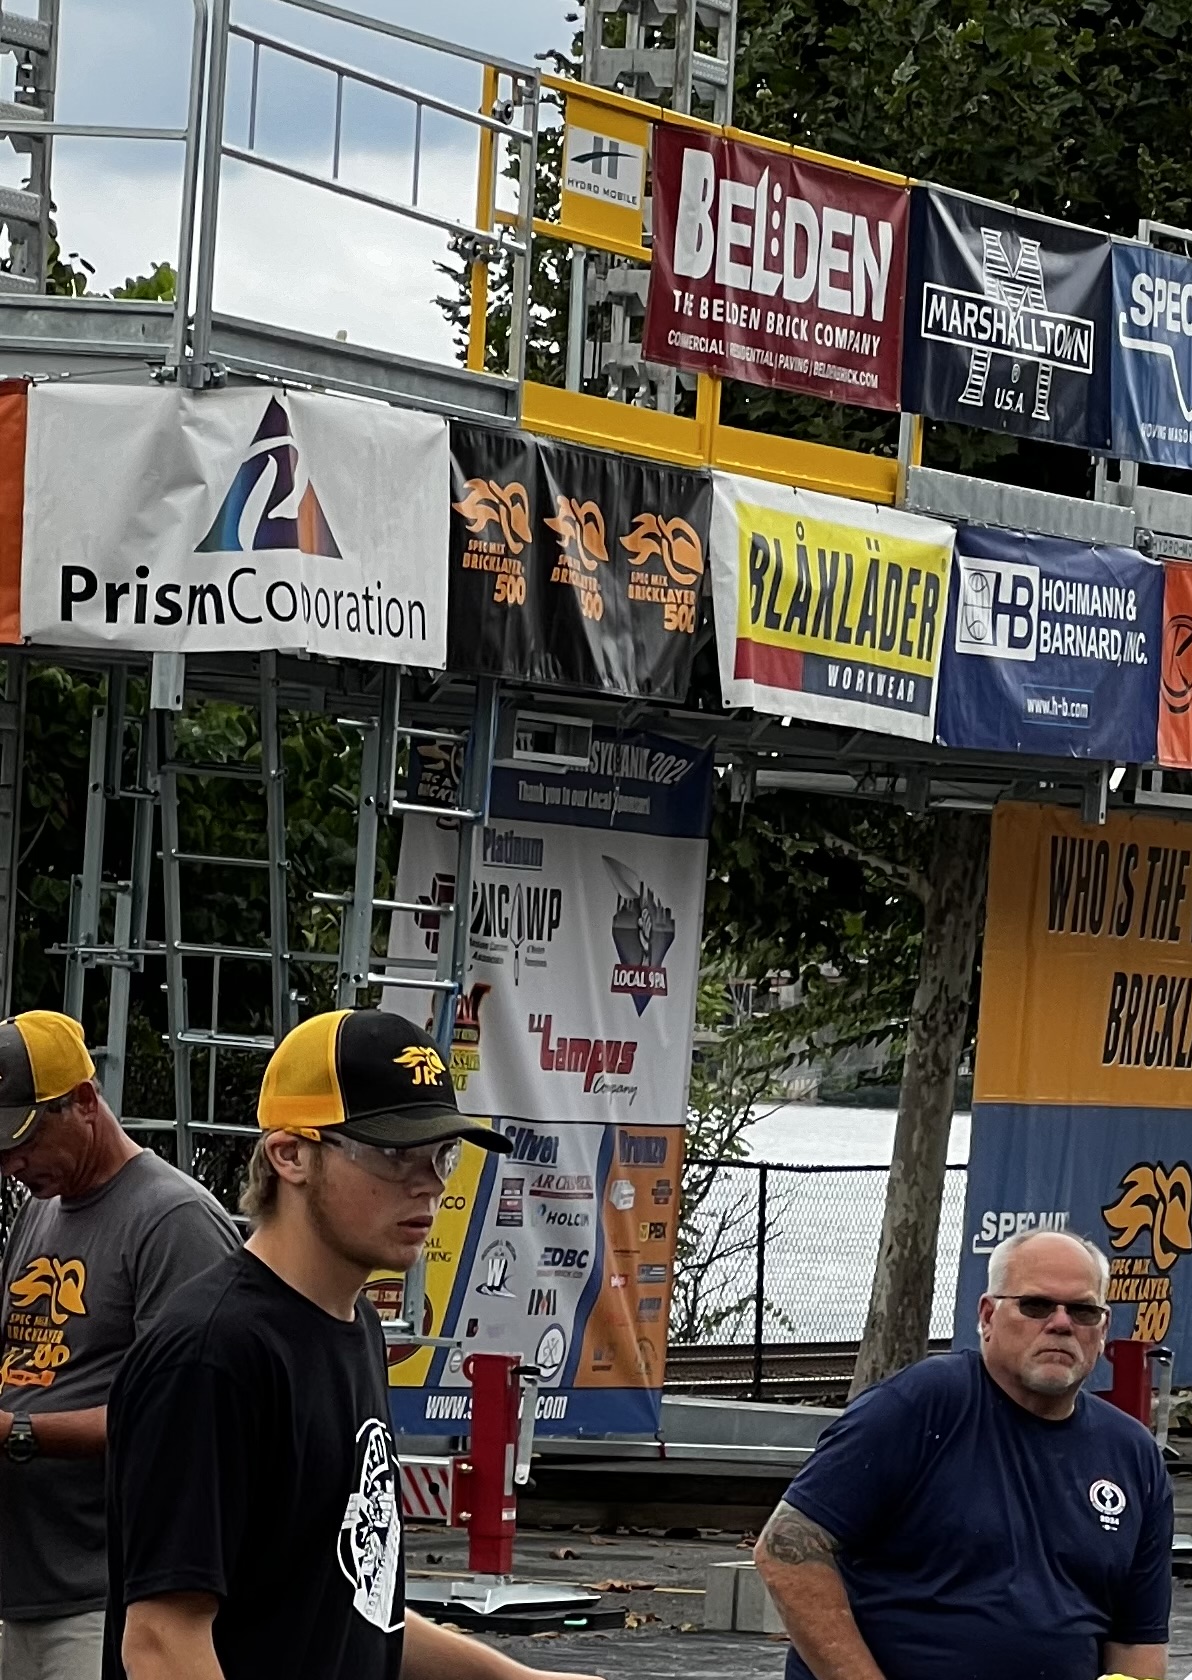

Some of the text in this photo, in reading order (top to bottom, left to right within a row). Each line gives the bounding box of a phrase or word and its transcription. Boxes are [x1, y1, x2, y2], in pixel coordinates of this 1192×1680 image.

[567, 178, 638, 206] HYDRO MOBILE
[673, 147, 894, 322] BELDEN
[699, 296, 761, 331] BELDEN
[766, 311, 808, 343] BRICK
[814, 322, 881, 358] COMPANY
[927, 294, 1090, 365] MARSHALLTOWN
[462, 552, 522, 576] BRICKLAYER
[493, 574, 527, 605] 500
[628, 583, 696, 606] BRICKLAYER
[828, 664, 916, 703] WORKWEAR
[1027, 695, 1089, 720] www.h-b.com
[1048, 835, 1110, 936] WHO
[1108, 843, 1140, 938] IS
[1139, 846, 1191, 943] THE
[614, 966, 646, 988] LOCAL
[1105, 1277, 1170, 1301] RICKLAYER
[1131, 1300, 1171, 1342] 500
